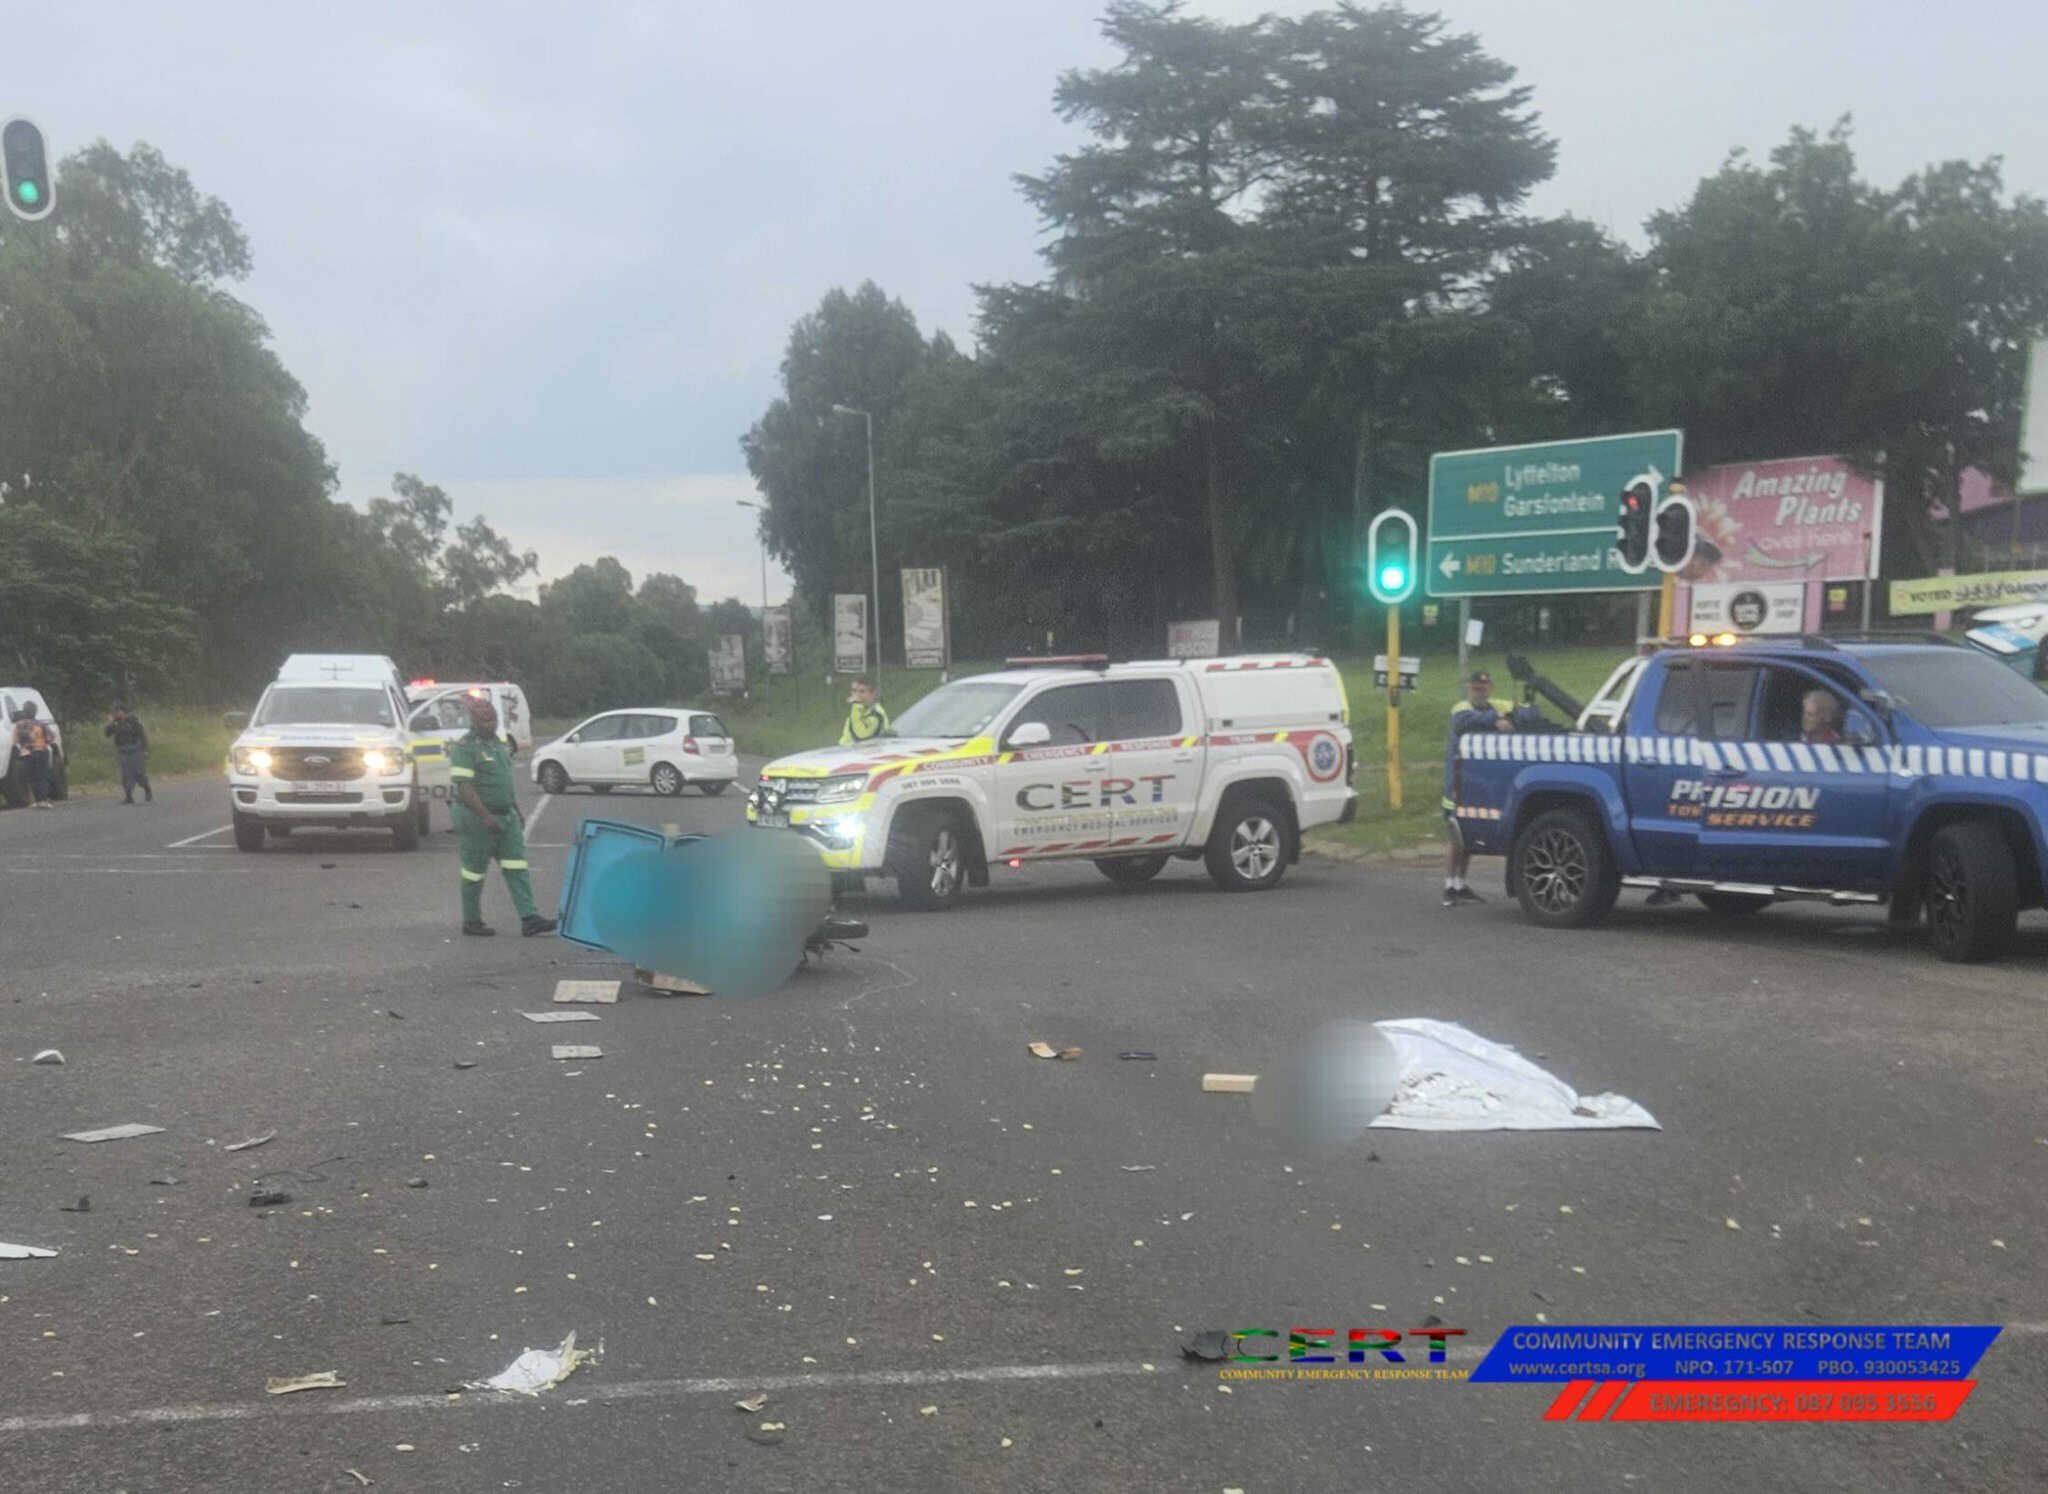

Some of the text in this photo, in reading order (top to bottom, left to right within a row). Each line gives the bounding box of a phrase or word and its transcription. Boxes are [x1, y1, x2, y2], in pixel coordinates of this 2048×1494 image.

[1732, 466, 1847, 499] Amazing
[1774, 496, 1862, 526] Plants
[1015, 774, 1176, 811] CERT
[1708, 812, 1817, 828] SERVICE
